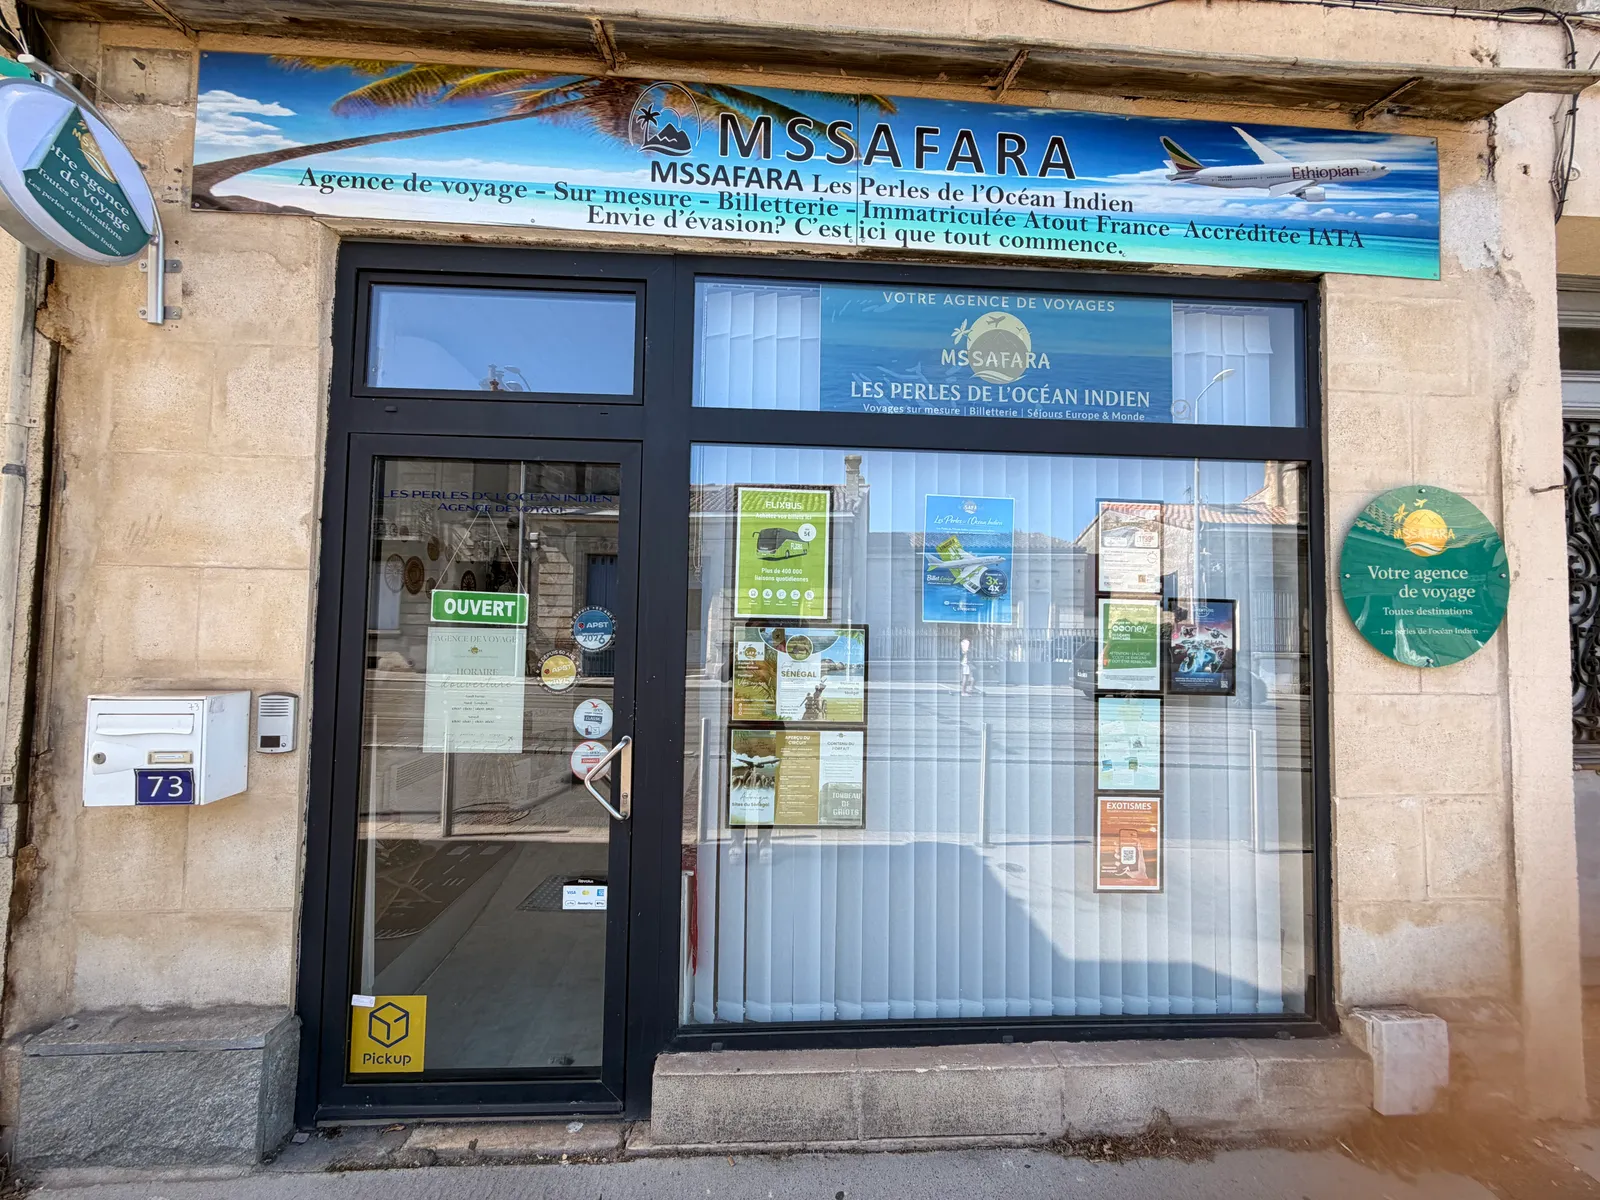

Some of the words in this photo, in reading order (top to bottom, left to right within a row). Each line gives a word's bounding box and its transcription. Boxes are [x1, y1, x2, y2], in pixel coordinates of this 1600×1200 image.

[718, 111, 1077, 181] MSSAFARA
[1291, 165, 1360, 180] Ethiopian
[80, 169, 130, 217] agence
[651, 160, 803, 192] MSSAFARA
[812, 174, 852, 196] Les
[859, 176, 931, 201] Perles
[938, 183, 964, 202] de
[1063, 190, 1134, 213] Indien
[27, 177, 41, 193] Les
[42, 189, 66, 213] perles
[65, 208, 76, 219] de
[37, 167, 70, 198] Toutes
[70, 194, 123, 242] destinations
[59, 169, 81, 190] de
[82, 185, 131, 234] voyage
[299, 166, 395, 196] Agence
[402, 170, 431, 194] de
[442, 180, 529, 205] voyage
[553, 180, 597, 203] Sur
[603, 186, 693, 208] mesure
[717, 191, 839, 218] Billetterie
[862, 204, 1016, 228] Immatriculée
[1024, 210, 1089, 233] Atout
[1096, 215, 1171, 237] France
[1182, 218, 1301, 244] Accréditée
[1308, 227, 1365, 248] IATA
[586, 204, 655, 229] Envie
[859, 221, 886, 241] ici
[894, 227, 936, 250] que
[943, 225, 990, 247] tout
[999, 232, 1125, 257] commence.
[882, 291, 936, 305] VOTRE
[943, 294, 1010, 308] AGENCE
[1016, 297, 1037, 309] DE
[1042, 298, 1116, 312] VOYAGES
[941, 348, 1051, 370] MSSAFARA
[850, 381, 884, 398] LES
[890, 382, 962, 401] PERLES
[967, 385, 992, 402] DE
[1083, 389, 1151, 408] INDIEN
[862, 403, 904, 415] Voyages
[906, 405, 922, 414] sur
[924, 406, 961, 416] mesure
[968, 406, 1018, 418] Billetterie
[1026, 407, 1064, 419] Séjours
[1065, 409, 1101, 421] Europe
[1101, 411, 1110, 420] &
[1111, 411, 1146, 422] Monde
[382, 489, 409, 499] LES
[411, 490, 470, 500] PERLES
[563, 493, 613, 503] INDIEN
[765, 501, 802, 510] FLIXBUS
[1393, 527, 1456, 540] MSSAFARA
[985, 576, 999, 585] 3x
[1367, 565, 1411, 580] Votre
[1414, 568, 1469, 583] agence
[1398, 584, 1419, 599] de
[1421, 586, 1476, 602] voyage
[444, 597, 516, 617] OUVERT
[1382, 606, 1414, 616] Toutes
[1416, 606, 1474, 616] destinations
[586, 621, 609, 629] APST
[1380, 627, 1394, 636] Les
[1417, 627, 1428, 635] de
[1454, 627, 1479, 635] Indien
[434, 635, 469, 643] AGENCE
[470, 635, 484, 643] DE
[456, 668, 499, 676] HORAIRE
[780, 668, 817, 678] SÉNÉGAL
[187, 702, 200, 711] 73
[147, 775, 184, 798] 73
[1106, 801, 1152, 811] EXOTISMES
[362, 1052, 412, 1067] Pickup
